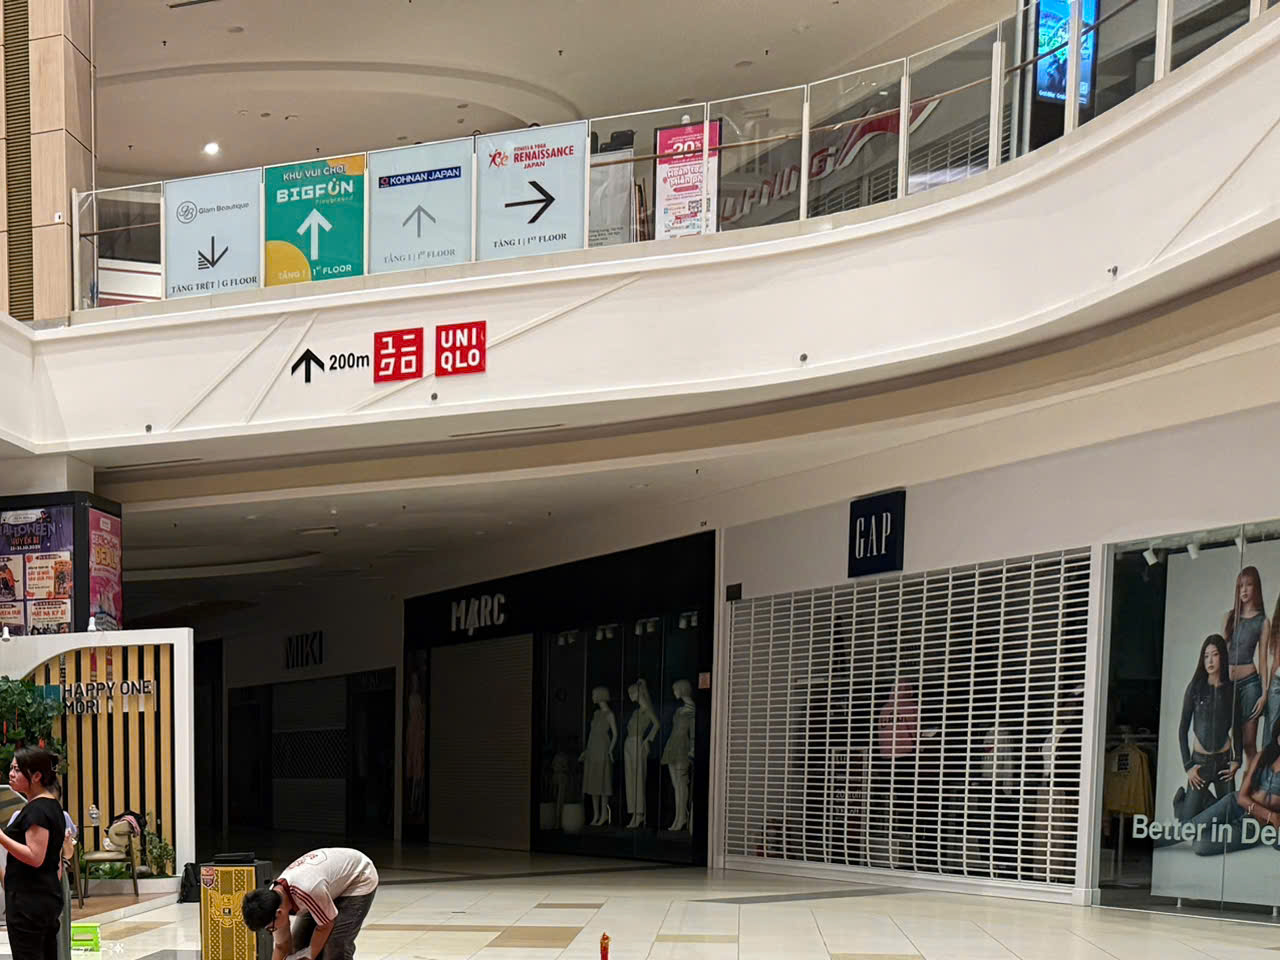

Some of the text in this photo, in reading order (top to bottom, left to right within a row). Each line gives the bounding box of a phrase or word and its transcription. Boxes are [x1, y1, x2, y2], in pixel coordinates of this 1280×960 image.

[513, 145, 574, 163] RENAISSANCE
[523, 160, 546, 169] JAPAN
[283, 171, 302, 181] KHU
[305, 168, 320, 177] VUI
[390, 168, 460, 185] KOHNAN JAPAN
[538, 232, 567, 244] FLOOR
[427, 249, 456, 258] FLOOR
[322, 264, 352, 275] FLOOR
[222, 278, 229, 288] G
[230, 276, 257, 287] FLOOR
[440, 327, 478, 349] UNI
[329, 353, 369, 371] 200m
[440, 349, 481, 372] QLO
[855, 511, 891, 559] GAP
[451, 593, 505, 636] MARC
[64, 680, 152, 698] HAPPY ONE
[64, 699, 100, 714] MORI
[1132, 814, 1280, 847] Better in De
